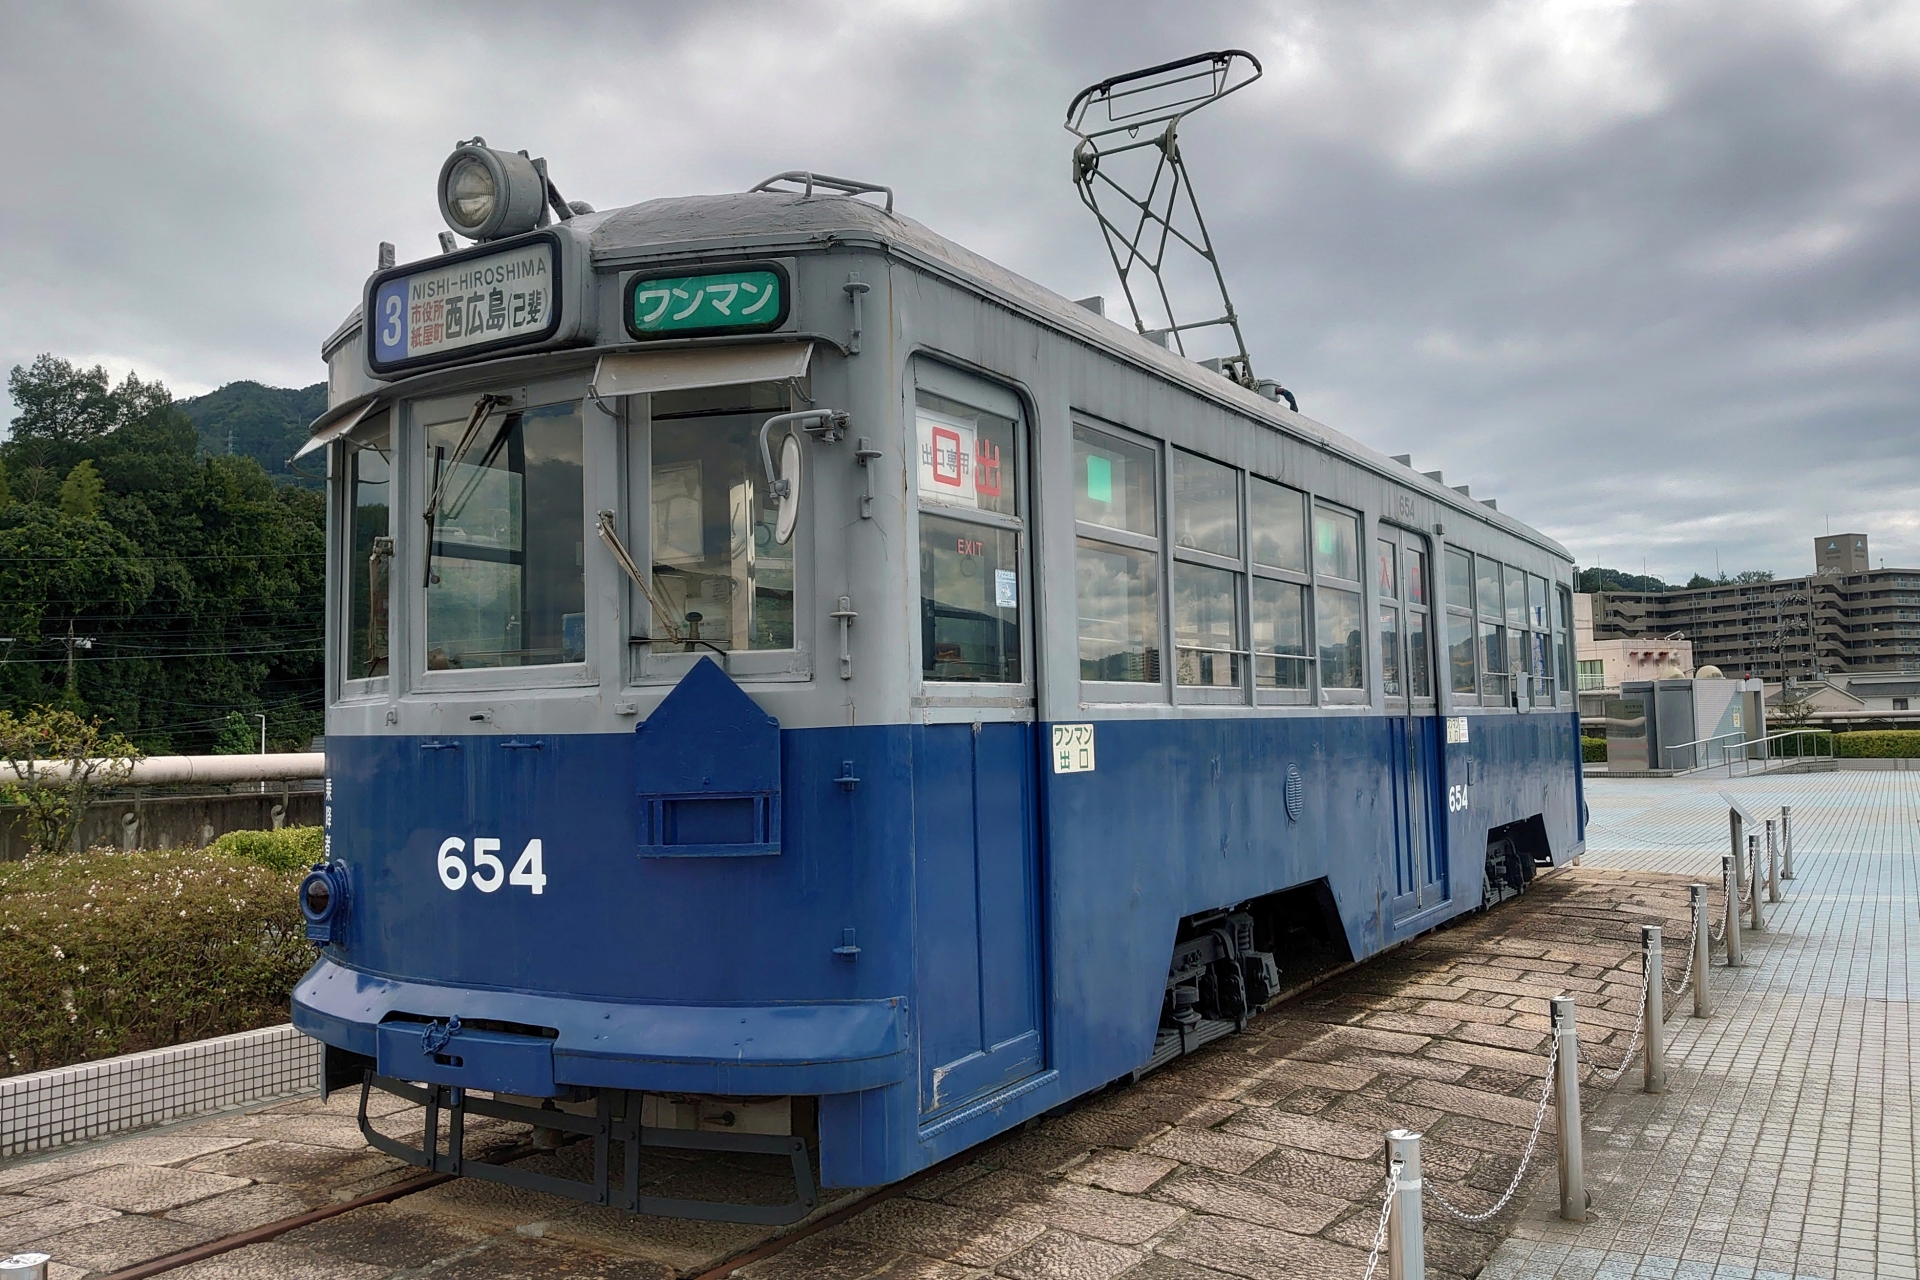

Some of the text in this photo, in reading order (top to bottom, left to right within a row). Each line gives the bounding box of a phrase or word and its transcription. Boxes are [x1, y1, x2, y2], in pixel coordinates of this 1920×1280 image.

[412, 257, 547, 300] NISHI-HIROSHIMA
[411, 299, 444, 325] 市役所
[640, 282, 773, 322] ワンマン
[383, 295, 402, 347] 3
[410, 322, 444, 349] 紙屋町
[1400, 495, 1415, 520] 654
[957, 538, 983, 556] EXIT
[1054, 726, 1093, 747] ワンマン
[1060, 748, 1089, 771] 出口
[1448, 783, 1469, 813] 654
[437, 836, 547, 895] 654
